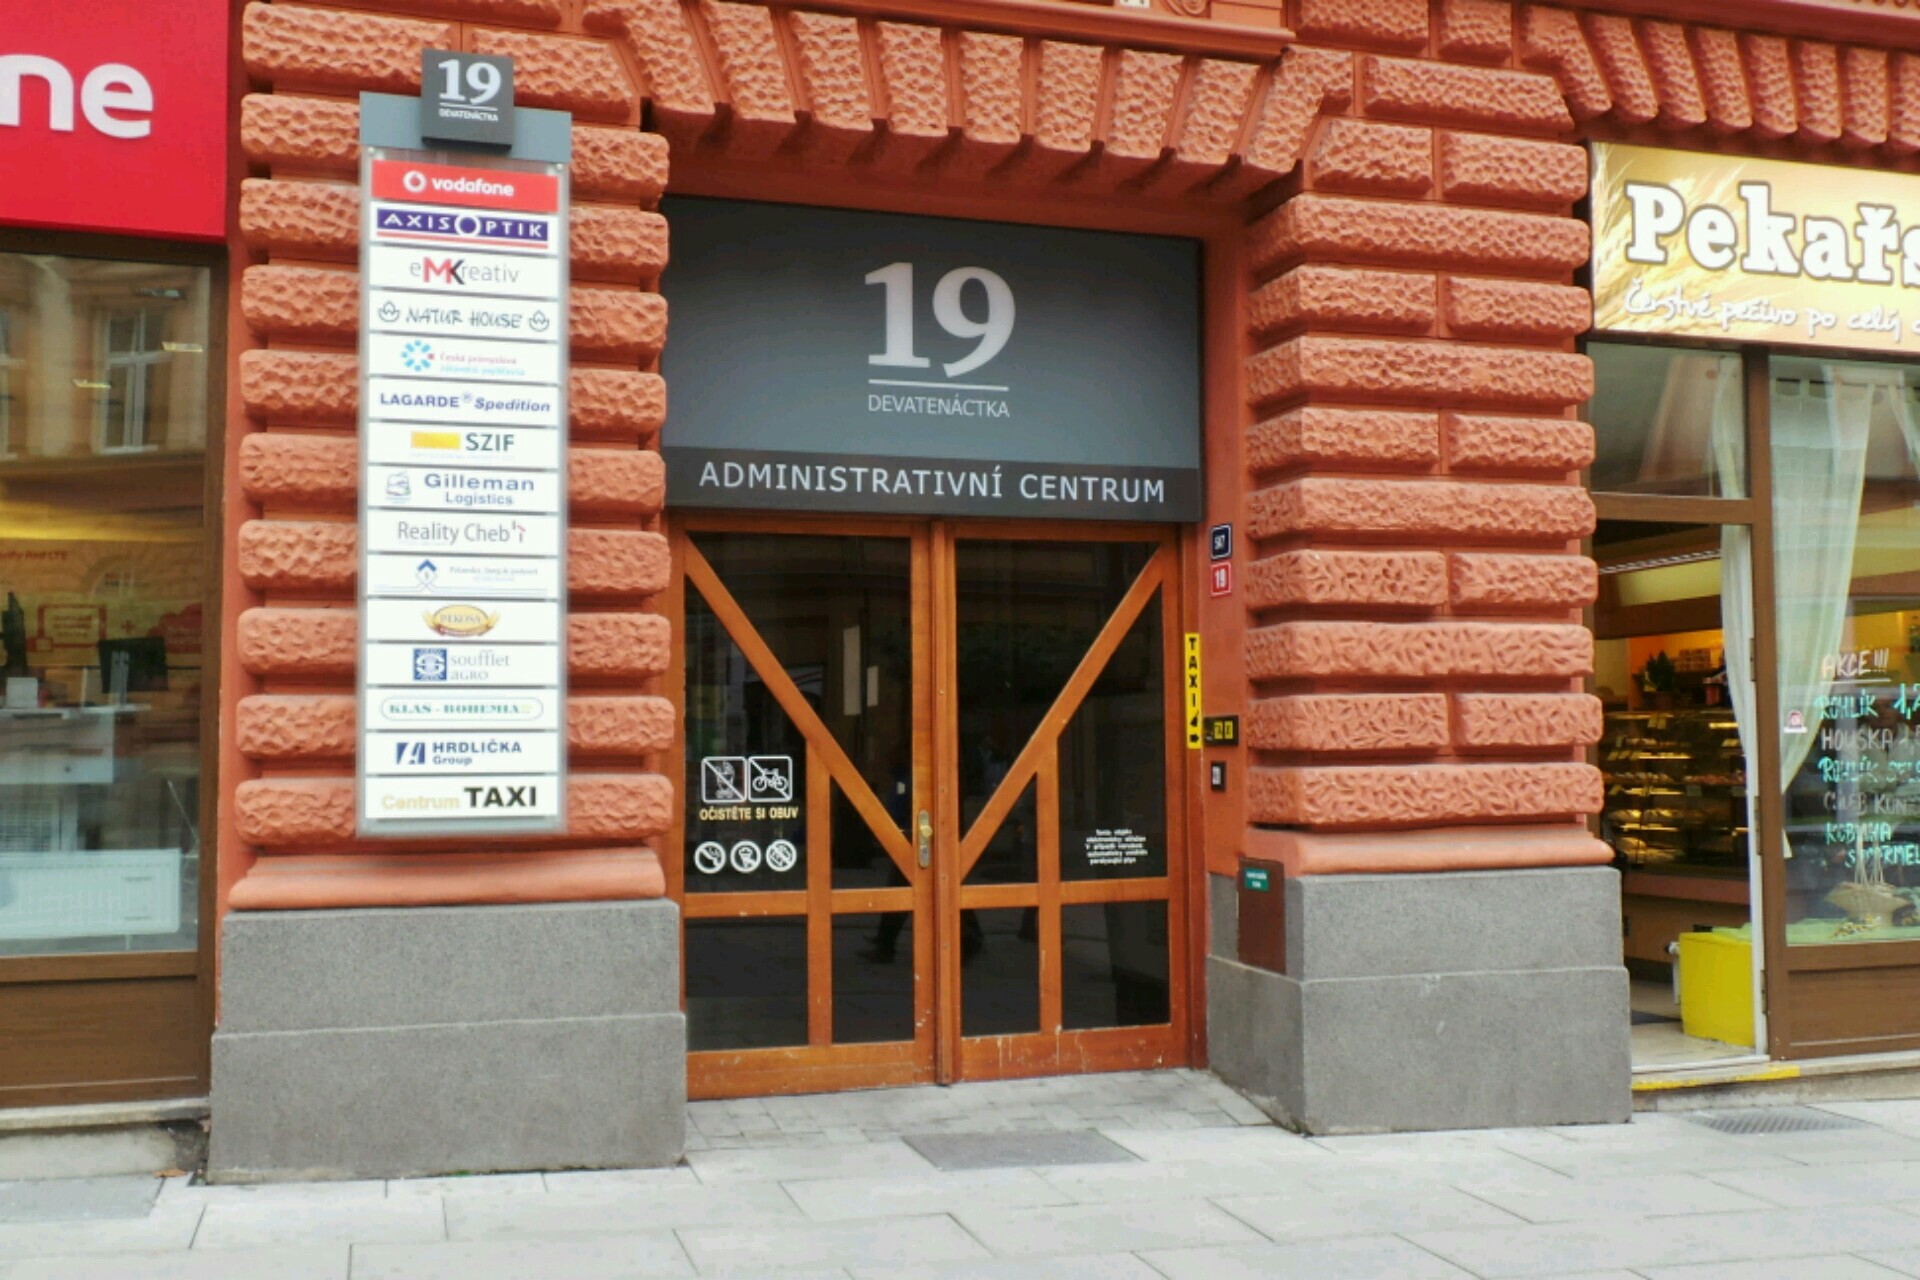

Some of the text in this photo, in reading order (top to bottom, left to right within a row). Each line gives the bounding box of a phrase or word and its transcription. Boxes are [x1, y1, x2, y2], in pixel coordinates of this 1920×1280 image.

[438, 59, 502, 105] 19
[431, 177, 515, 196] vodafone
[406, 308, 523, 329] NATUR HOUSE
[865, 262, 1016, 377] 19
[1624, 279, 1716, 320] Čerstvé
[1719, 299, 1797, 331] pečivo
[1805, 308, 1837, 338] po
[1846, 304, 1900, 342] celý
[474, 397, 551, 417] Spedition
[867, 392, 1010, 418] DEVATENÁCTKA
[465, 432, 515, 452] SZIF
[424, 473, 534, 491] Gilleman
[699, 461, 1165, 502] ADMINISTRATIVNÍ CENTRUM
[446, 491, 514, 506] Logistics
[398, 520, 459, 546] Reality
[450, 650, 510, 667] soufflet
[1188, 637, 1198, 707] TAXI
[432, 739, 522, 753] HRDLIČKA
[1821, 726, 1894, 752] HOUSKA
[432, 756, 473, 766] Group
[382, 786, 537, 810] Centrum TAXI
[699, 806, 799, 820] OČISTĚTE SI OBUV
